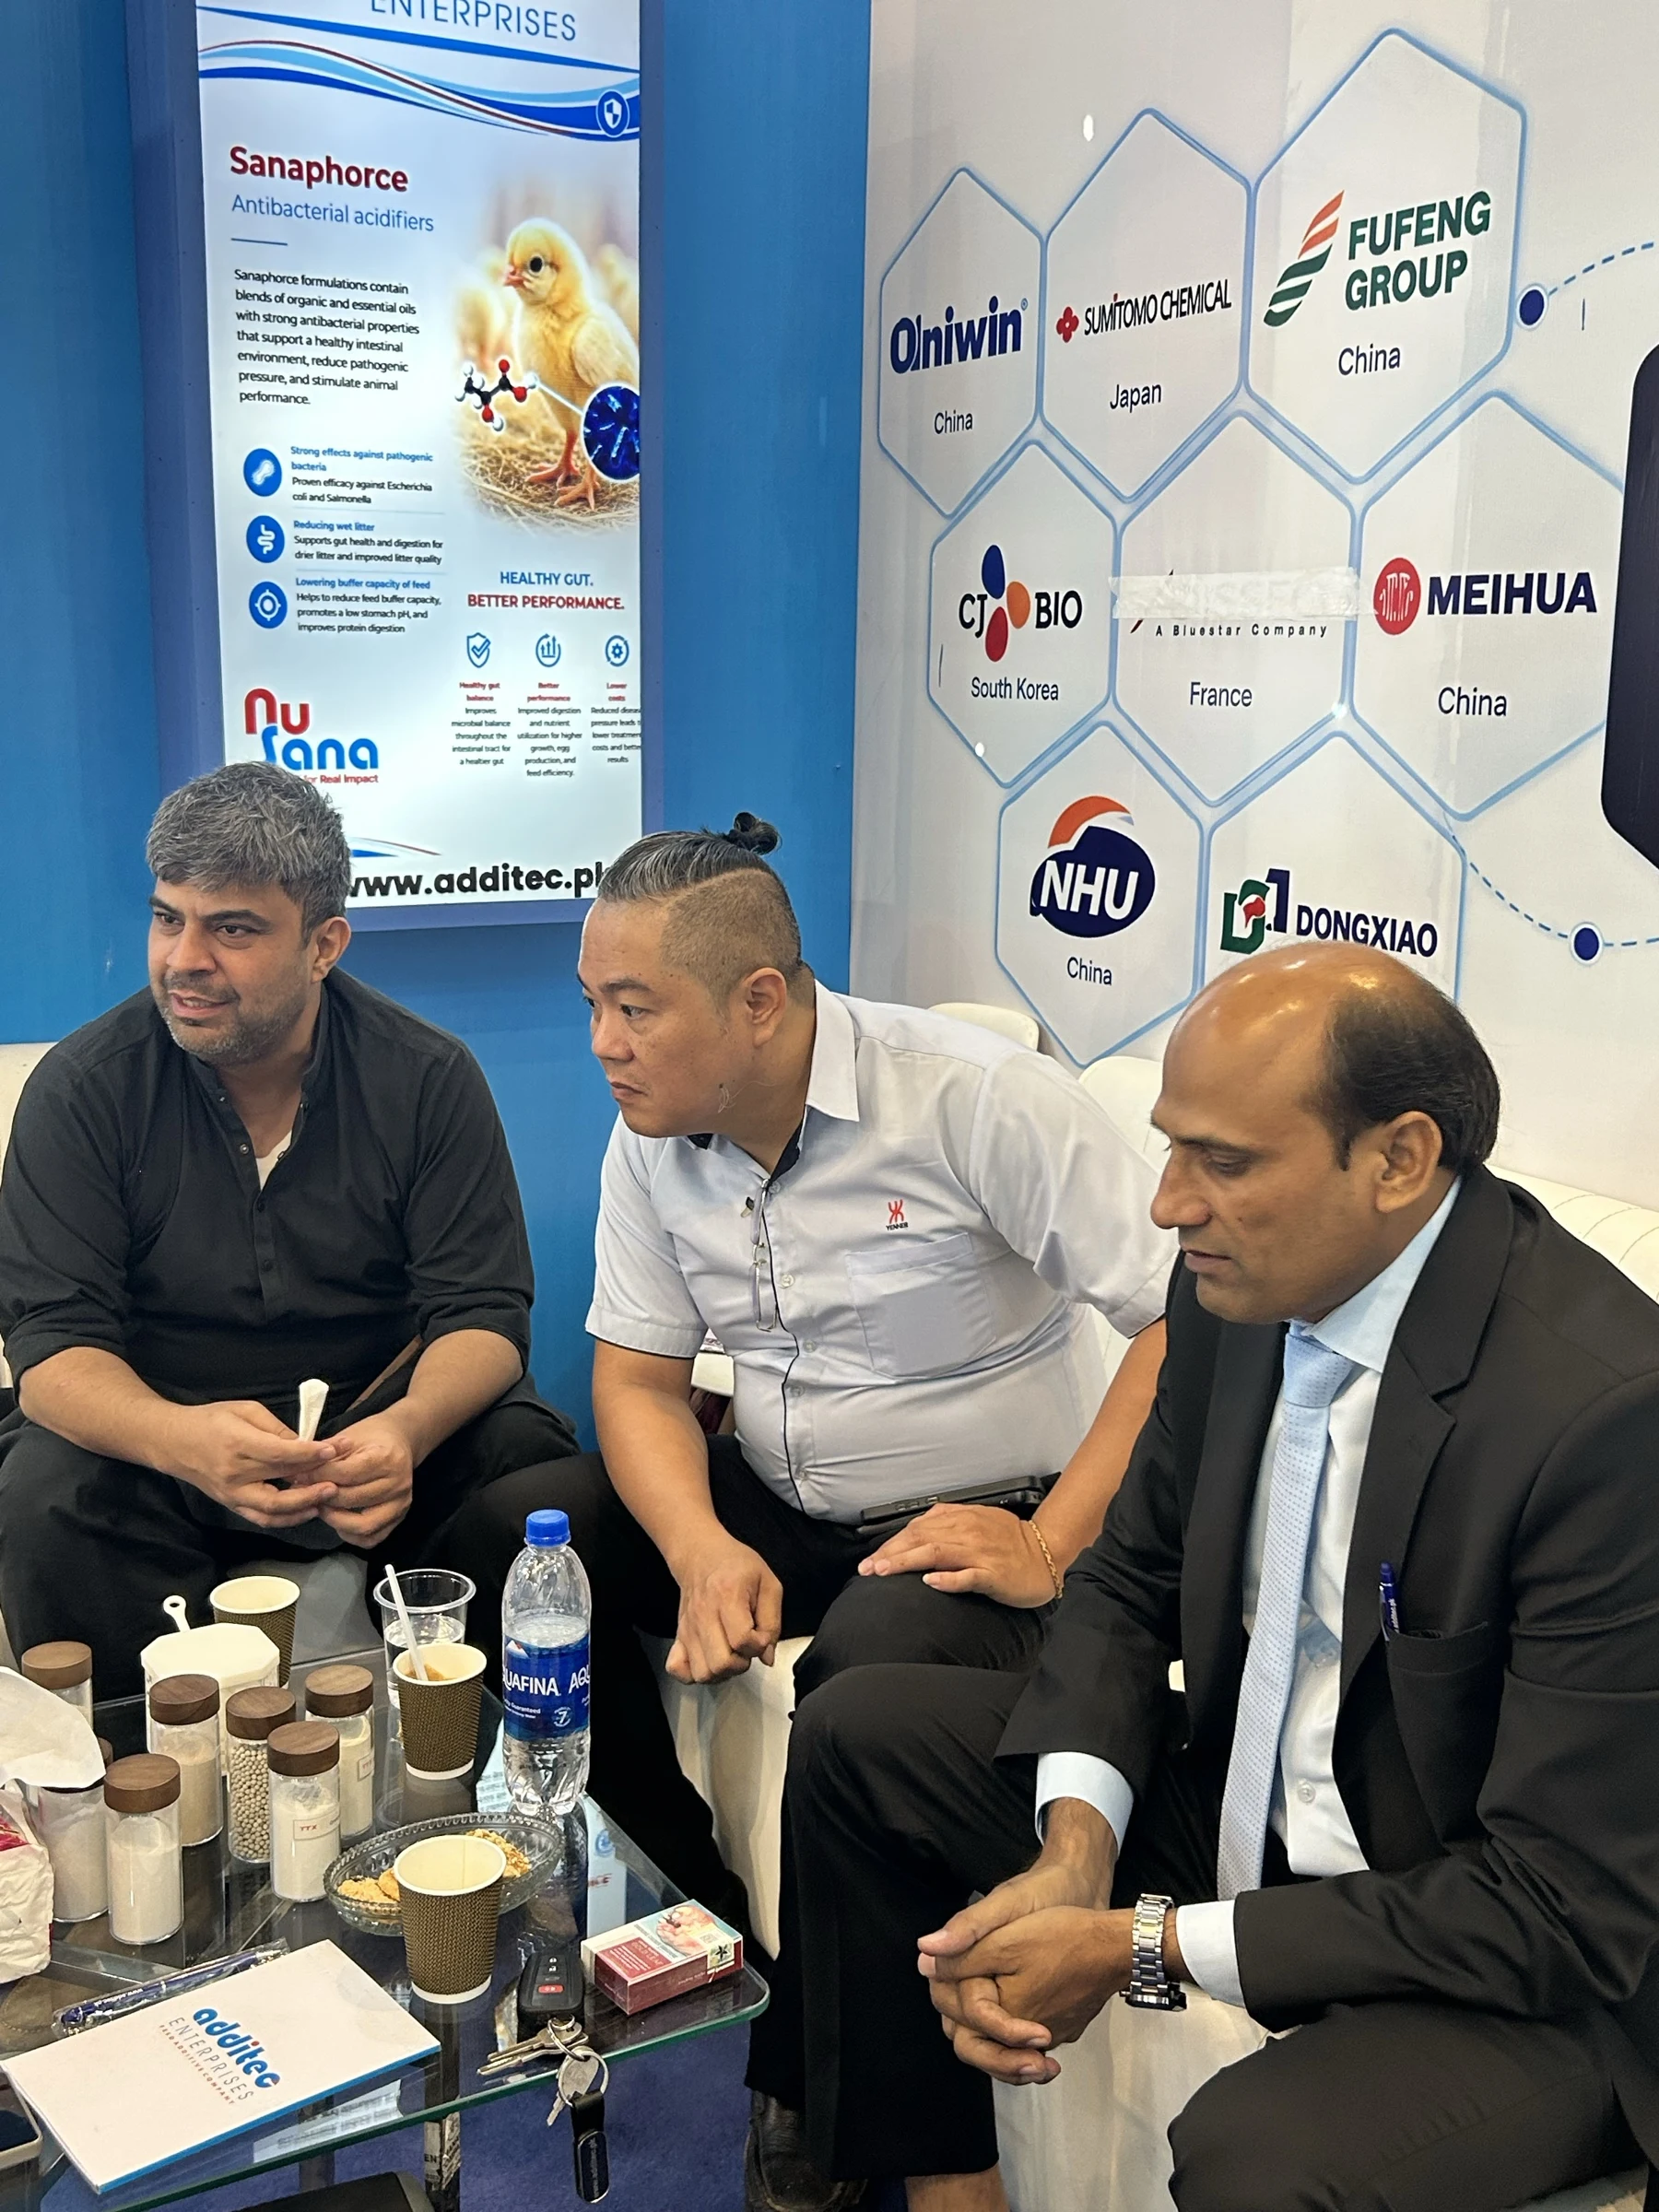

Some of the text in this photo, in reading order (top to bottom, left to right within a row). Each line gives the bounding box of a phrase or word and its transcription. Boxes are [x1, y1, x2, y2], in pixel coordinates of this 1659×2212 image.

[229, 146, 408, 192] Sanaphorce
[231, 194, 434, 231] Antibacterial acidifiers
[1348, 191, 1491, 261] FUFENG
[234, 269, 408, 294] Sanaphorce formulations contain
[1345, 249, 1467, 312] GROUP
[236, 289, 417, 315] blends of organic and essential oils
[1084, 279, 1231, 335] SUMITOMO CHEMICAL
[236, 310, 419, 335] with strong antibacterial properties
[237, 330, 403, 352] that support a healthy intestinal
[238, 351, 408, 373] environment, reduce pathogenic
[1338, 344, 1400, 376] China
[239, 371, 398, 391] pressure, and stimulate animal
[240, 391, 311, 405] performance.
[1111, 384, 1161, 413] Japan
[934, 409, 973, 434] China
[290, 446, 433, 463] Strong effects against pathogenic
[291, 462, 326, 471] bacteria
[292, 477, 432, 491] Proven efficacy against Escherichia
[293, 493, 371, 503] coli and Salmonella
[294, 521, 334, 532] Reducing
[355, 523, 374, 532] litter
[294, 535, 443, 548] Supports gut health and digestion for
[295, 551, 441, 565] drier litter and improved litter quality
[296, 578, 430, 590] Lowering buffer capacity of feed
[500, 571, 594, 586] HEALTHY GUT.
[297, 594, 320, 603] Helps
[332, 594, 360, 603] reduce
[362, 594, 380, 603] feed
[382, 594, 405, 604] buffer
[406, 595, 441, 606] capacity,
[467, 594, 625, 610] BETTER PERFORMANCE.
[1428, 572, 1597, 616] MEIHUA
[297, 608, 336, 618] promotes
[346, 609, 359, 618] low
[361, 609, 396, 618] stomach
[398, 610, 411, 619] pH,
[413, 610, 428, 618] and
[959, 590, 1082, 639] CJ BIO
[298, 623, 405, 634] improves protein digestion
[1156, 623, 1327, 638] A Bluestar Company
[459, 682, 500, 690] Healthy gut
[971, 677, 1059, 700] South Korea
[1190, 682, 1253, 707] France
[527, 694, 571, 702] performance
[1438, 687, 1507, 716] China
[518, 707, 582, 715] Improved digestion
[591, 706, 619, 714] Reduced
[492, 758, 505, 766] gut
[320, 774, 341, 783] Real
[344, 774, 379, 784] Impact
[1040, 859, 1139, 920] NHU
[1296, 904, 1438, 958] DONGXIAO
[1066, 957, 1112, 986] China
[169, 2017, 254, 2100] ENTERPRISES
[193, 2008, 280, 2088] additec
[159, 2025, 235, 2104] FEED ADDITIVE COMPANY
